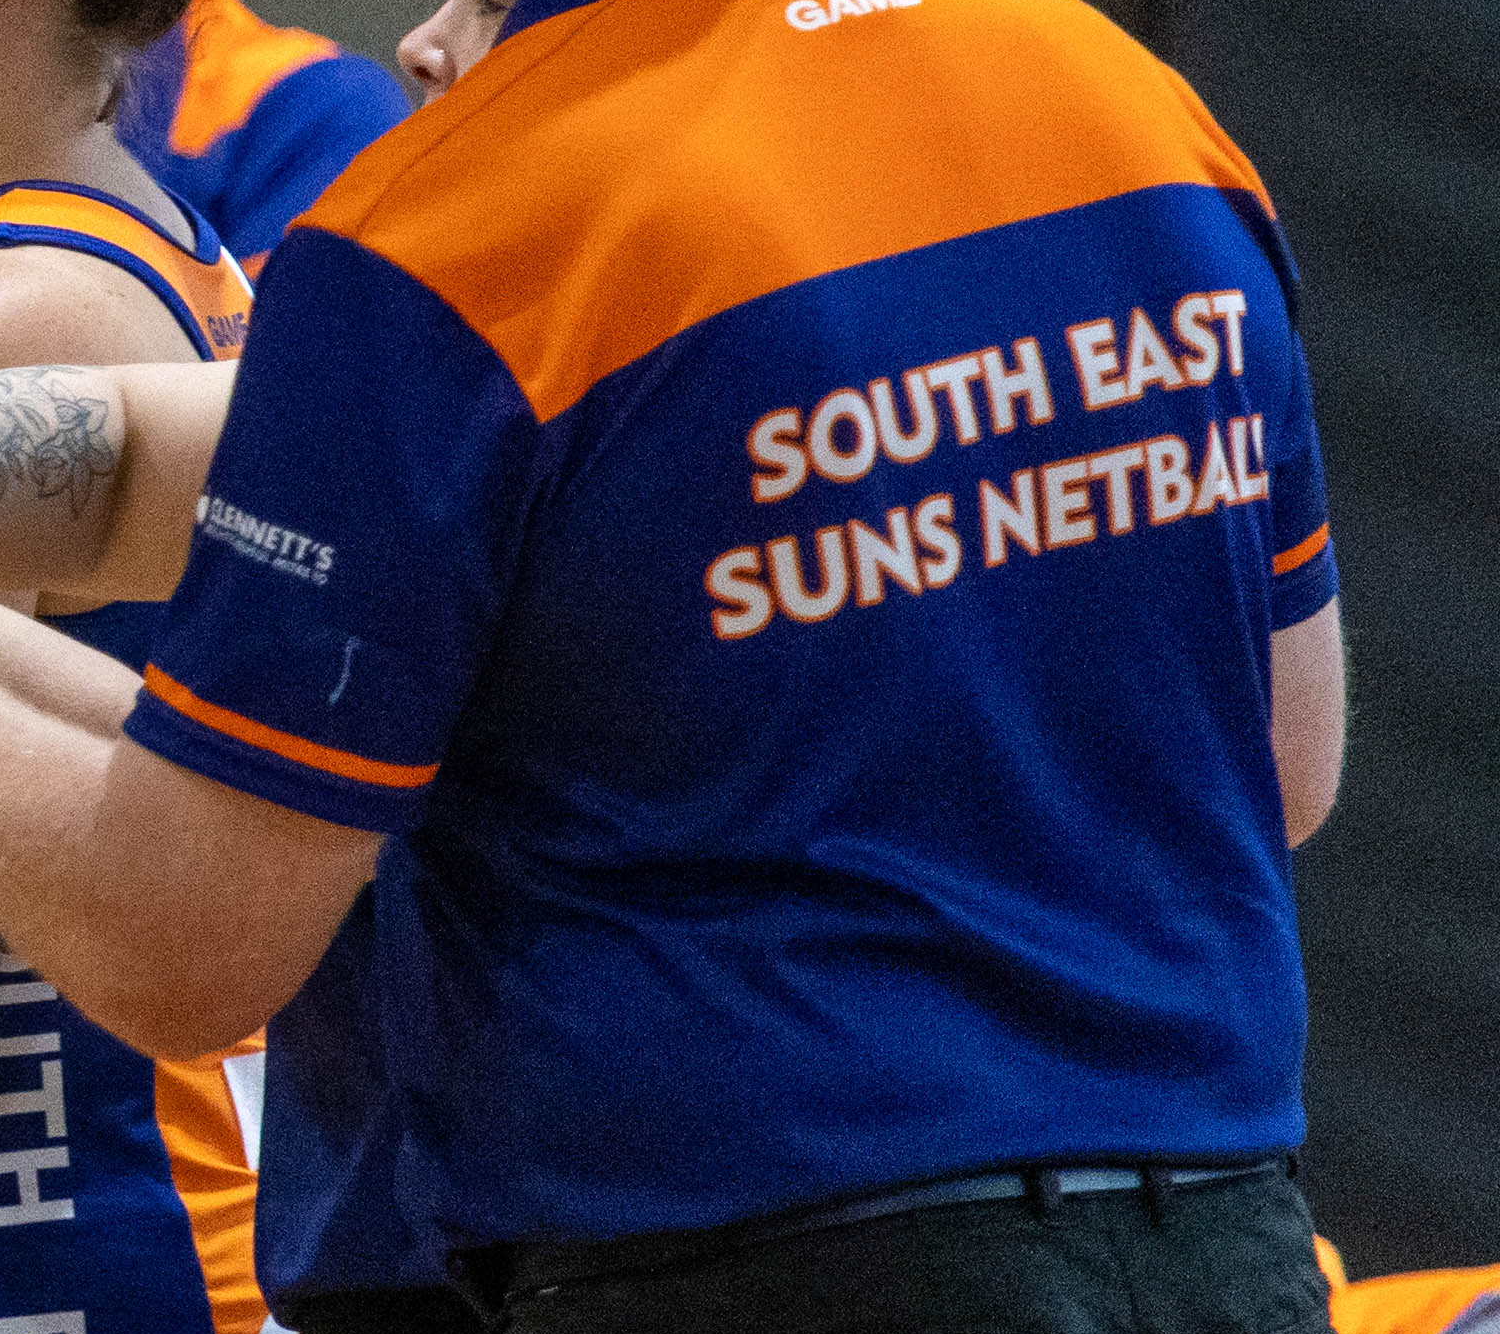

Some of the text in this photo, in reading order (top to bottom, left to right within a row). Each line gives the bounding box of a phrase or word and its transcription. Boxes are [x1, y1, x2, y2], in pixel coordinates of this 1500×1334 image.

[747, 290, 1247, 503] SOUTH EAST
[705, 492, 962, 641] SUNS
